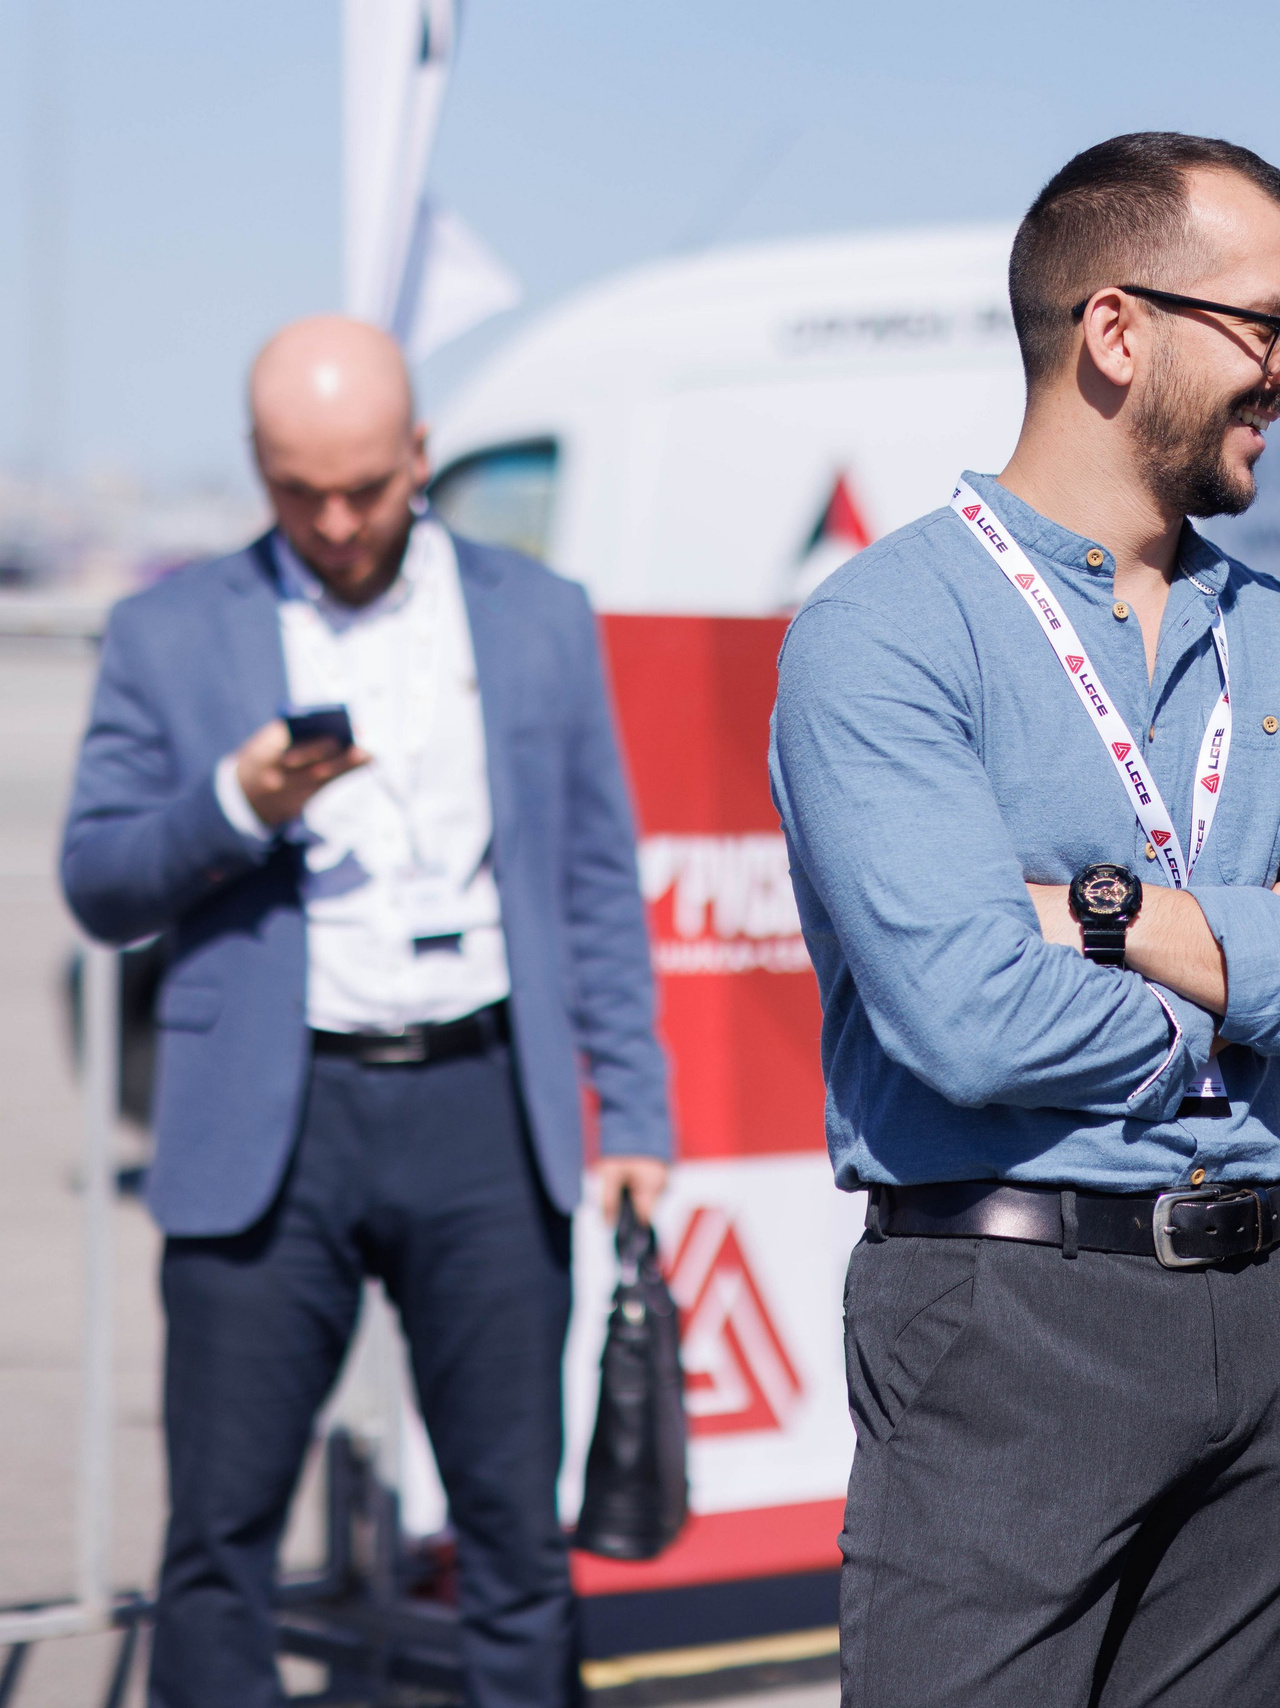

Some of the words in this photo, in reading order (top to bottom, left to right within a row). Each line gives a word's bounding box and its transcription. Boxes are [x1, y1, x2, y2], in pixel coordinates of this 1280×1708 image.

[976, 517, 1009, 553] LGCE
[1031, 589, 1062, 630] LGCE
[1079, 673, 1109, 717] LGCE
[1208, 728, 1225, 770] LGCE
[1125, 760, 1152, 806] LGCE
[1192, 819, 1206, 865] LGCE
[1163, 847, 1182, 889] LGCE
